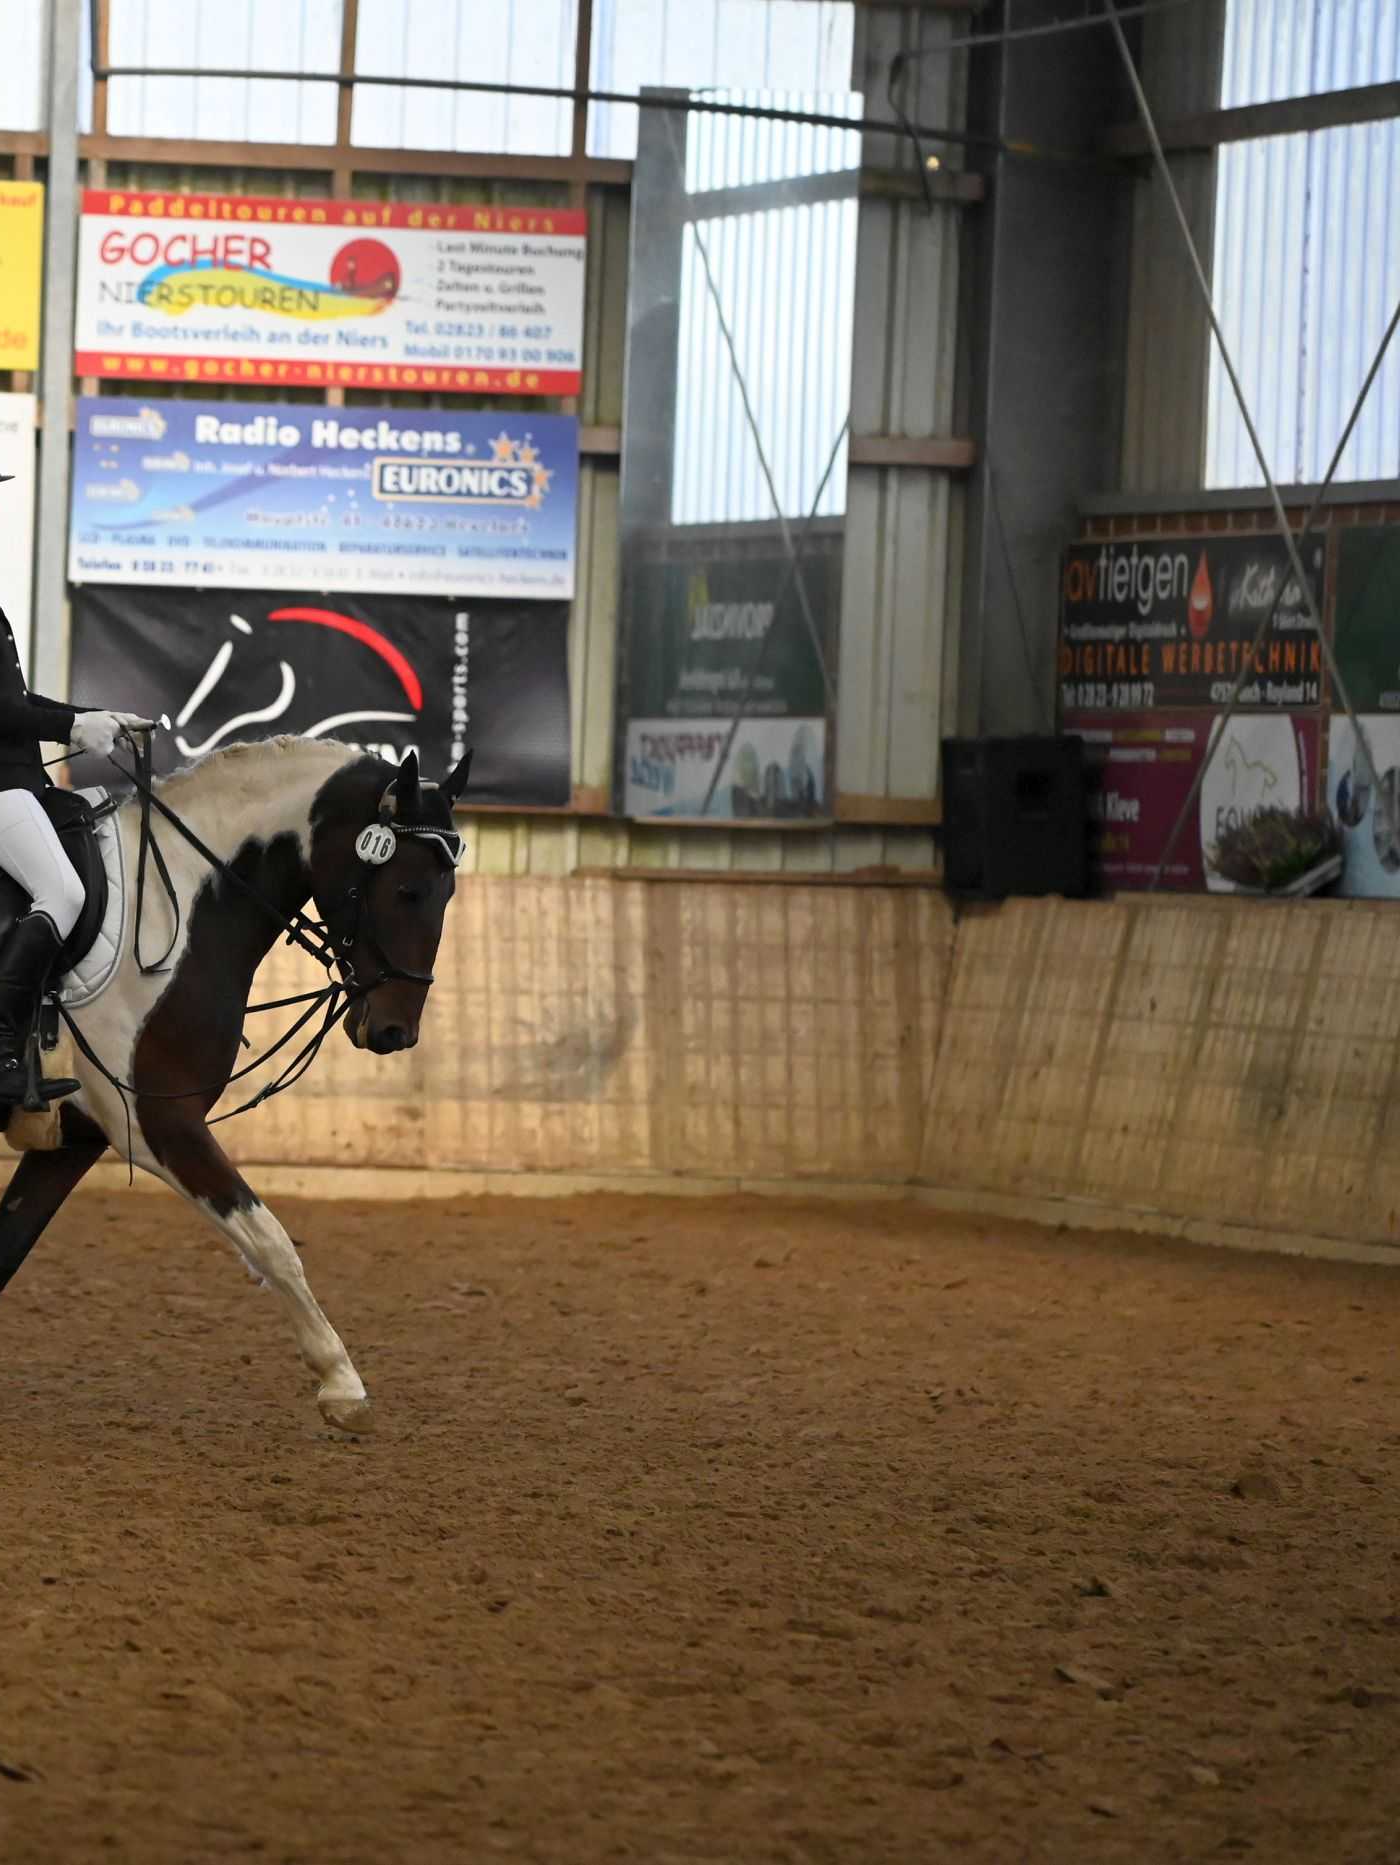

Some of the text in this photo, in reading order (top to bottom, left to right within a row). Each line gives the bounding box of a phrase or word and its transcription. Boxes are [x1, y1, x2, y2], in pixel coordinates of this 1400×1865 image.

[108, 194, 555, 234] Paddeltouren auf der Niers
[100, 229, 273, 271] GOCHER
[99, 279, 320, 313] NIERSTOUREN
[95, 319, 390, 350] Ihr Bootsverleih an der Niers
[102, 355, 540, 389] www.gocher-nierstouren.de
[195, 414, 301, 448] Radio
[311, 417, 462, 454] Heckens
[382, 465, 529, 498] EURONICS
[77, 556, 123, 571] Telefon
[1061, 641, 1151, 674] DIGITALE
[360, 830, 392, 859] 016
